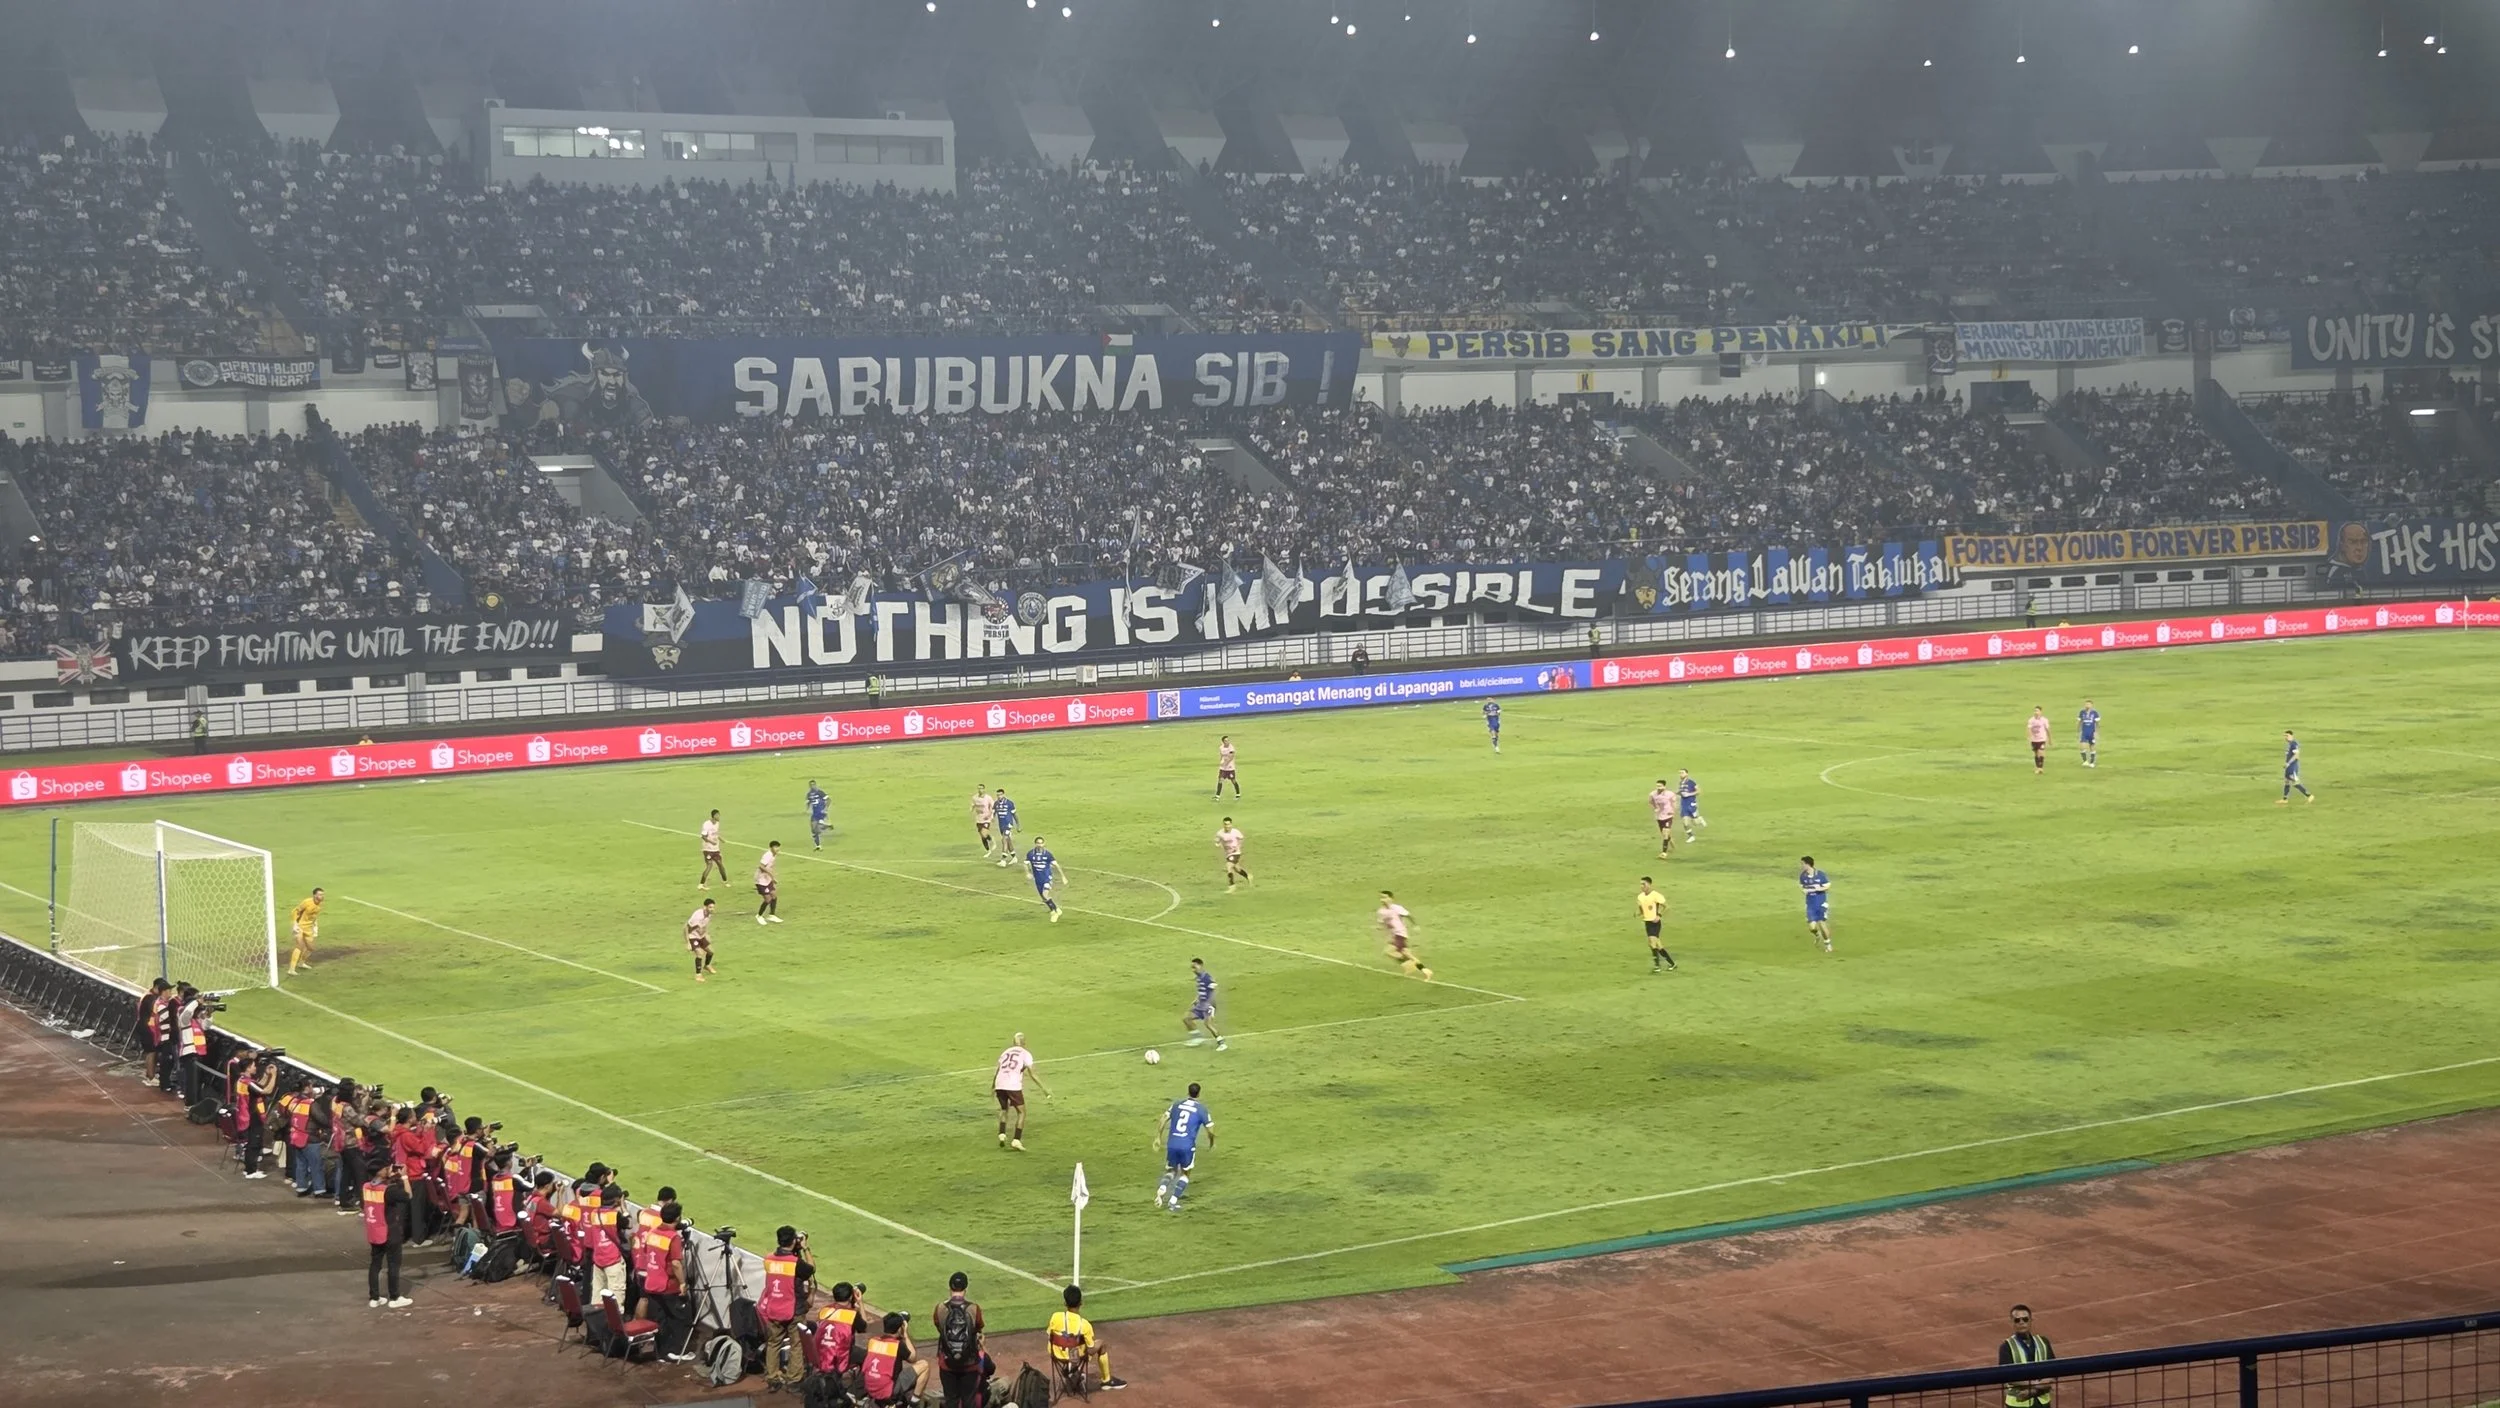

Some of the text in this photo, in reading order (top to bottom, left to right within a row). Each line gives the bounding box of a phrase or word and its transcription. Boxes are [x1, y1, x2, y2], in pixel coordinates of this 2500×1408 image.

[1427, 331, 1570, 359] PERSIB
[1592, 330, 1696, 358] SANG
[273, 361, 315, 375] BLOOD
[222, 372, 312, 387] PERSIB HEART
[734, 350, 1335, 417] SABUBUKNA SIB !
[1581, 373, 1589, 390] K
[2131, 528, 2237, 559] FOREVER
[2241, 524, 2322, 552] PERSIB
[2371, 524, 2437, 575] THE
[1662, 566, 1747, 606] Serang
[2277, 621, 2308, 632] Shopee
[2338, 615, 2369, 628] Shopee
[2389, 612, 2426, 625] Shopee
[751, 595, 1087, 669] NOTHING
[1110, 585, 1180, 646] IS
[2171, 629, 2204, 640] Shopee
[2225, 625, 2256, 636] Shopee
[129, 619, 559, 671] KEEP FIGHTING UNTIL THE END!!!
[2003, 640, 2037, 653] Shopee
[2060, 636, 2094, 649] Shopee
[2116, 632, 2149, 645] Shopee
[1874, 649, 1909, 663] Shopee
[1933, 645, 1968, 658] Shopee
[1750, 658, 1788, 672] Shopee
[1812, 654, 1849, 668] Shopee
[1621, 667, 1660, 681] Shopee
[1686, 663, 1724, 676] Shopee
[1246, 679, 1454, 706] Semangat Menang di Lapangan
[1009, 711, 1056, 726] Shopee
[1088, 705, 1134, 720] Shopee
[841, 722, 891, 738] Shopee
[926, 716, 975, 732] Shopee
[664, 735, 717, 752] Shopee
[754, 728, 805, 744] Shopee
[458, 750, 514, 766] Shopee
[553, 743, 608, 759] Shopee
[256, 764, 316, 781] Shopee
[358, 756, 417, 774] Shopee
[41, 778, 105, 797] Shopee
[151, 771, 213, 789] Shopee
[1001, 1052, 1020, 1070] 25
[1177, 1109, 1190, 1133] 2
